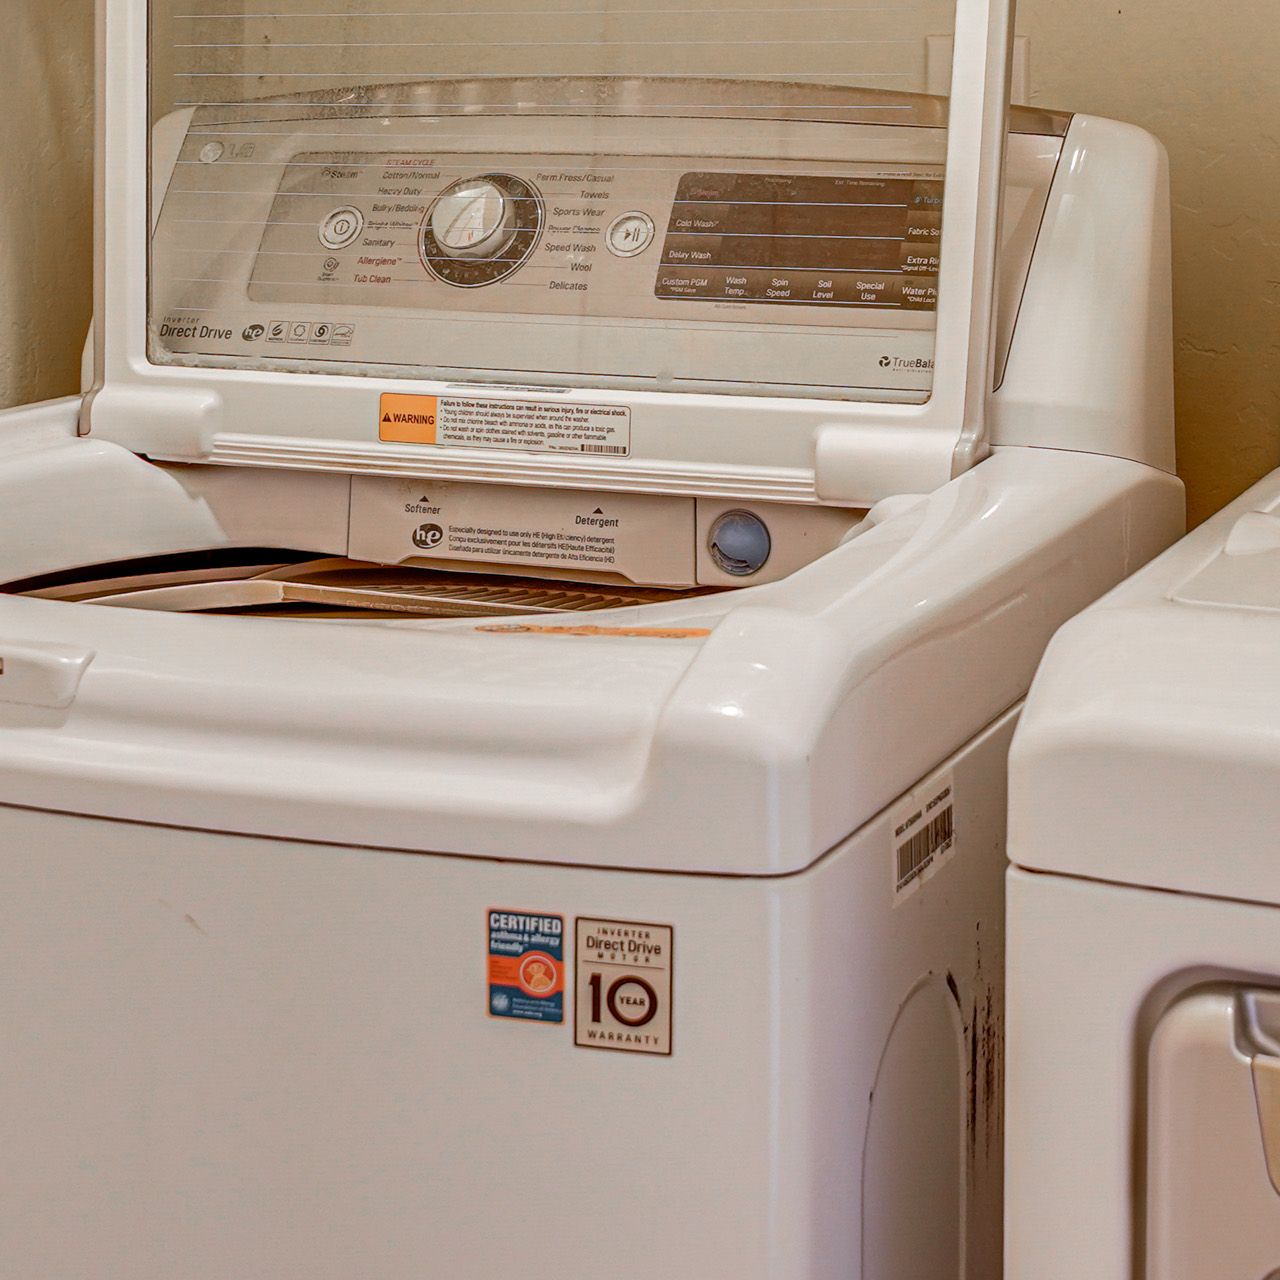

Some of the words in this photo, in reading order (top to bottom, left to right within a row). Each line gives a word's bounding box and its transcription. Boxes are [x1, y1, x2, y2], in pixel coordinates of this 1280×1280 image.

[580, 190, 610, 200] Towels
[553, 207, 580, 217] Sports
[582, 208, 606, 217] Wear
[676, 219, 692, 228] Cold
[908, 227, 929, 236] Fabric
[545, 243, 570, 253] Speed
[573, 244, 597, 253] Wash
[669, 250, 690, 260] Delay
[690, 251, 711, 260] Wash
[907, 256, 928, 265] Extra
[570, 263, 593, 272] Wool
[354, 274, 368, 283] Tub
[369, 274, 392, 283] Clean
[662, 277, 689, 286] Custom
[726, 276, 747, 285] Wash
[771, 278, 789, 287] Spin
[818, 279, 832, 288] Soil
[549, 280, 588, 291] Delicates
[856, 281, 885, 291] Special
[766, 288, 790, 298] Speed
[813, 290, 833, 299] Level
[902, 286, 926, 296] Water
[861, 292, 876, 301] Use
[159, 324, 197, 338] Direct
[199, 325, 233, 340] Drive
[393, 412, 435, 425] WARNING
[404, 503, 441, 515] Softener
[575, 515, 619, 528] Detergent
[490, 912, 562, 933] CERTIFIED
[597, 927, 651, 939] INVERTER
[586, 936, 624, 951] Direct
[628, 940, 661, 955] Drive
[597, 952, 650, 963] MOTOR
[588, 972, 658, 1027] 10
[619, 995, 646, 1007] YEAR
[587, 1029, 659, 1045] WARRANTY
